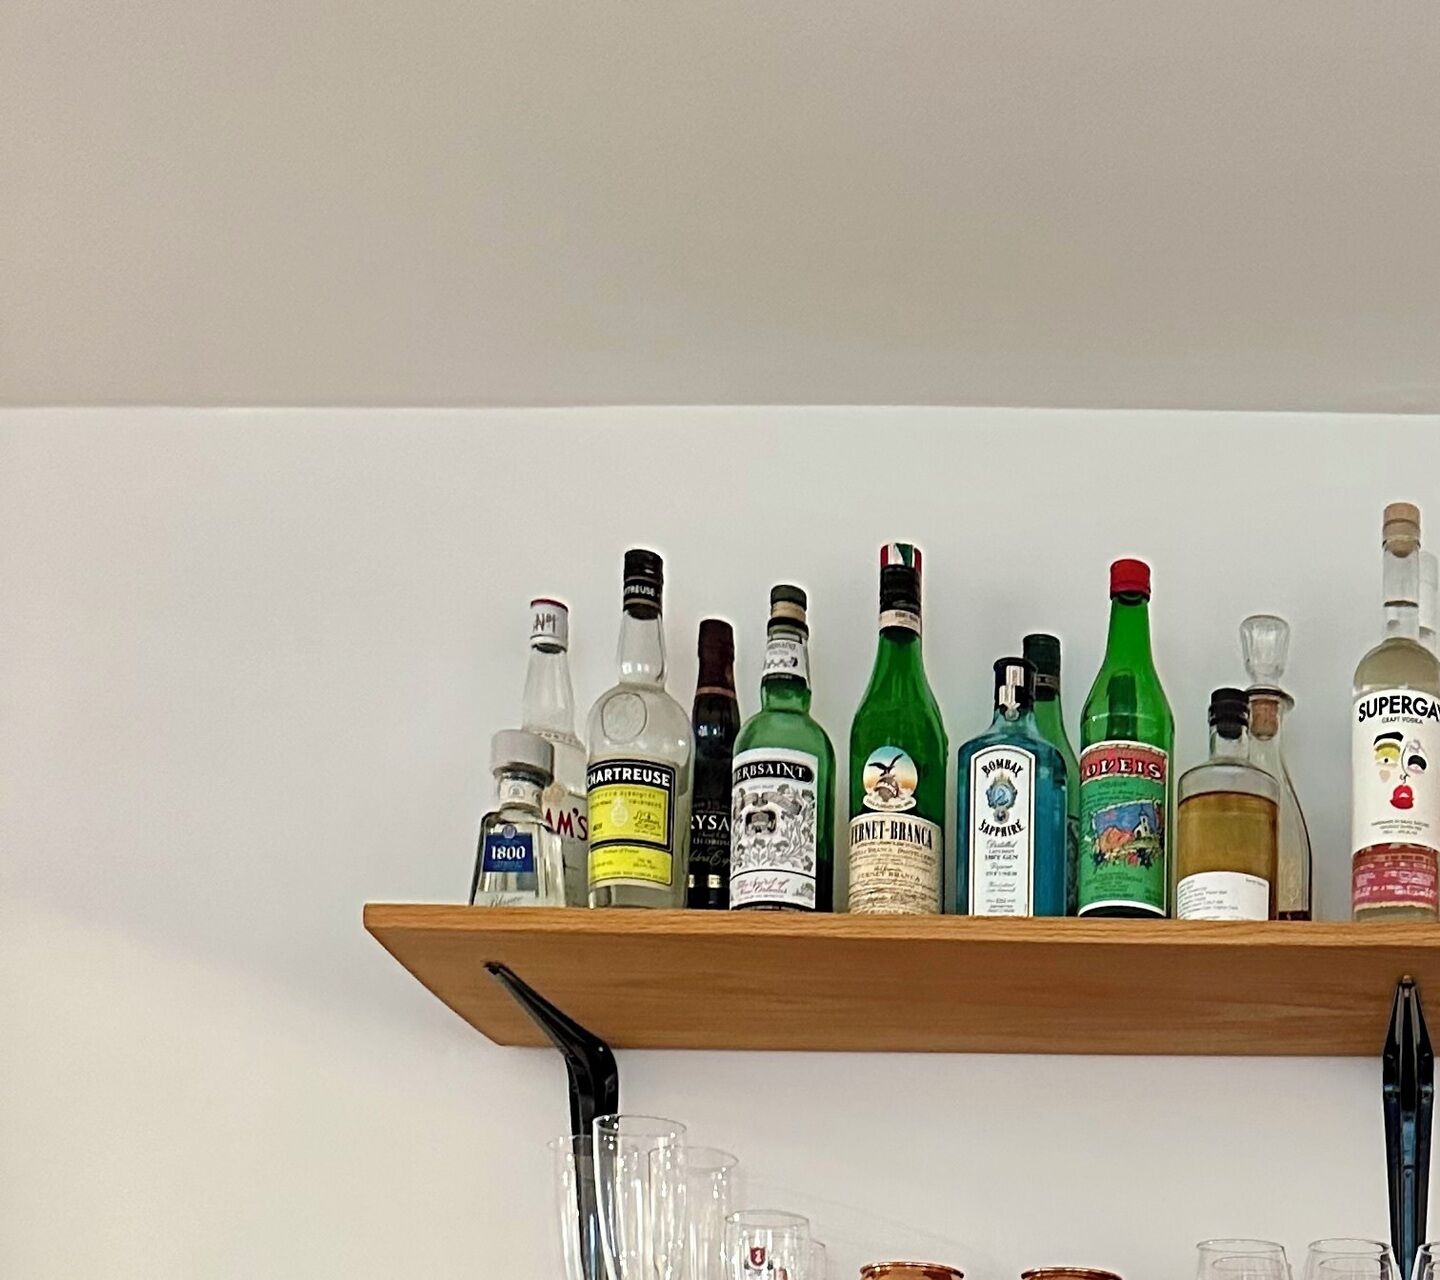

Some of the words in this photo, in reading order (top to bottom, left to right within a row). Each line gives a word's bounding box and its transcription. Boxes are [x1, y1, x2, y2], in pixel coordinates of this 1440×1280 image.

[981, 758, 1024, 779] BOMBAY
[978, 818, 1027, 837] SAPPHIRE
[491, 845, 526, 860] 1800
